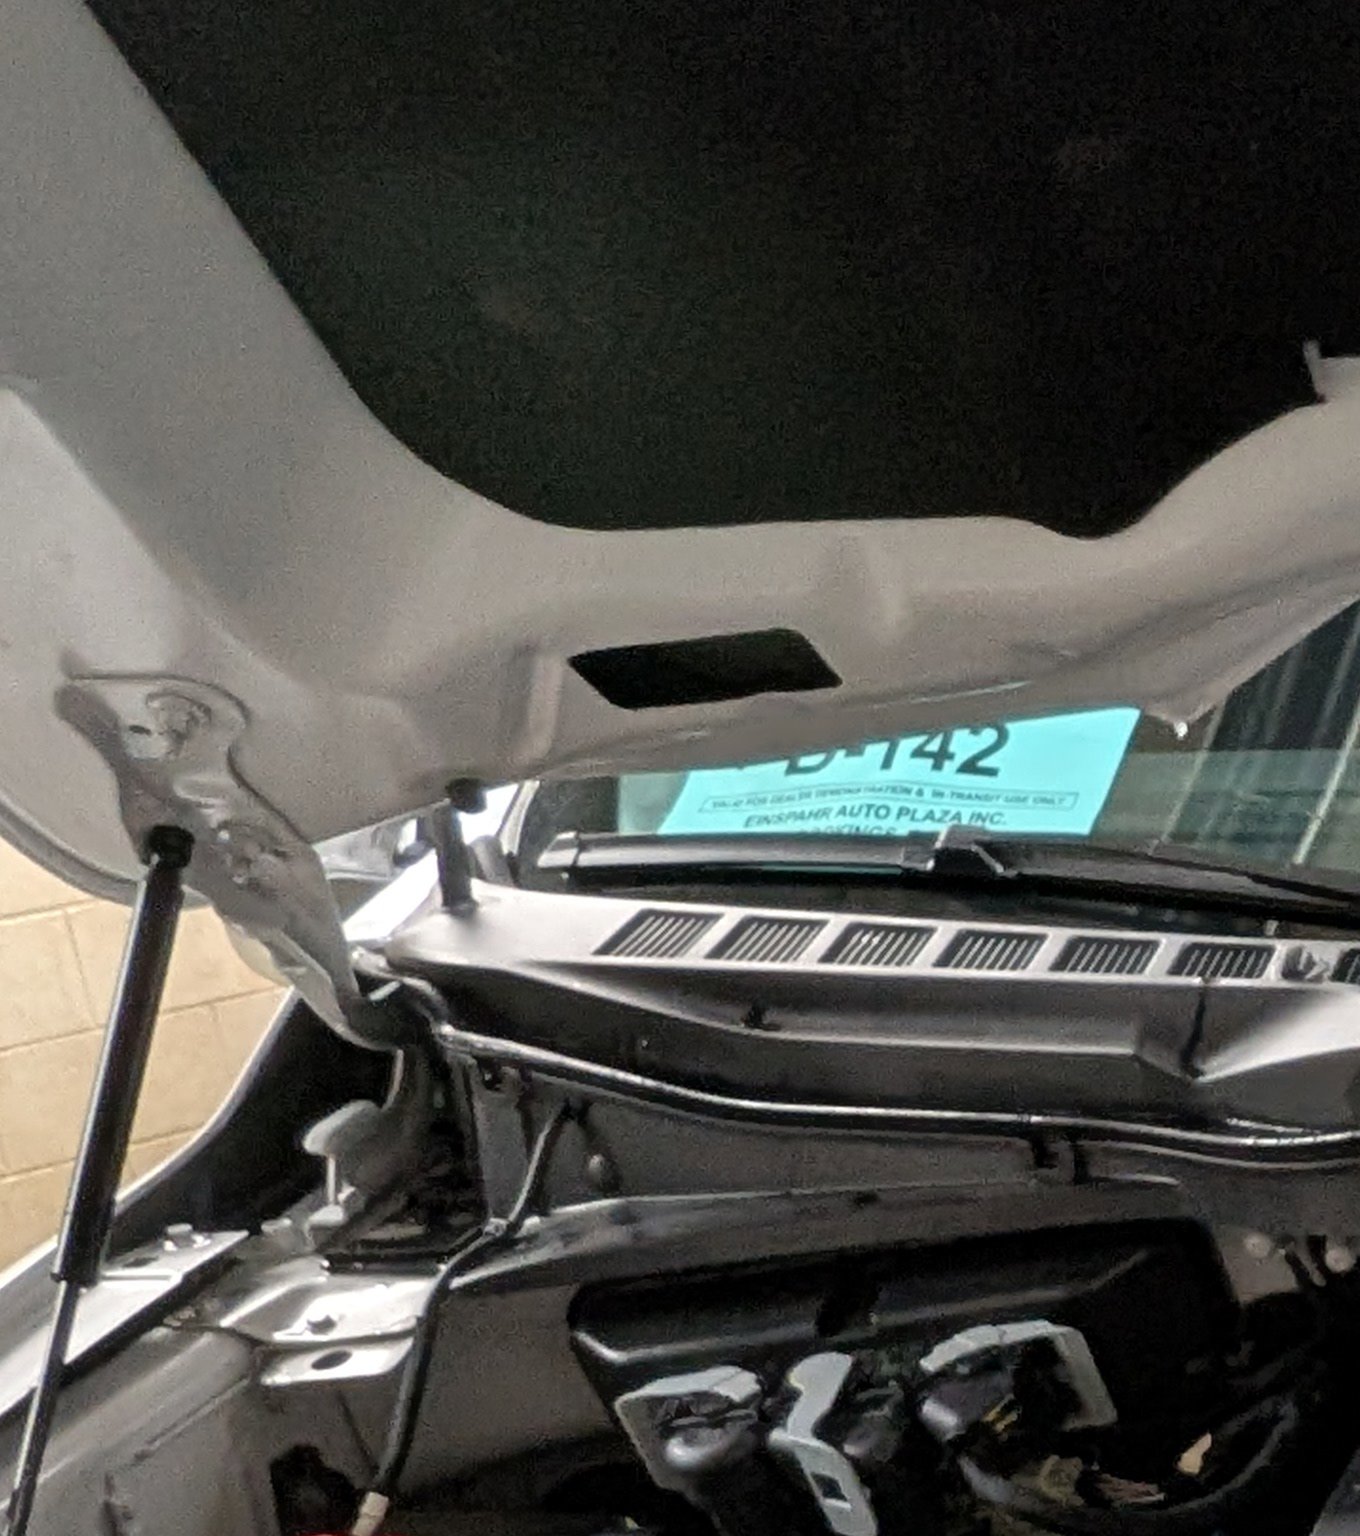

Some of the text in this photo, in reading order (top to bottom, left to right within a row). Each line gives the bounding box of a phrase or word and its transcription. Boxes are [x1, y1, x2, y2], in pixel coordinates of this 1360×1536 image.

[835, 803, 891, 820] AUTO
[895, 806, 963, 824] PLAZA
[968, 810, 1008, 826] INC.
